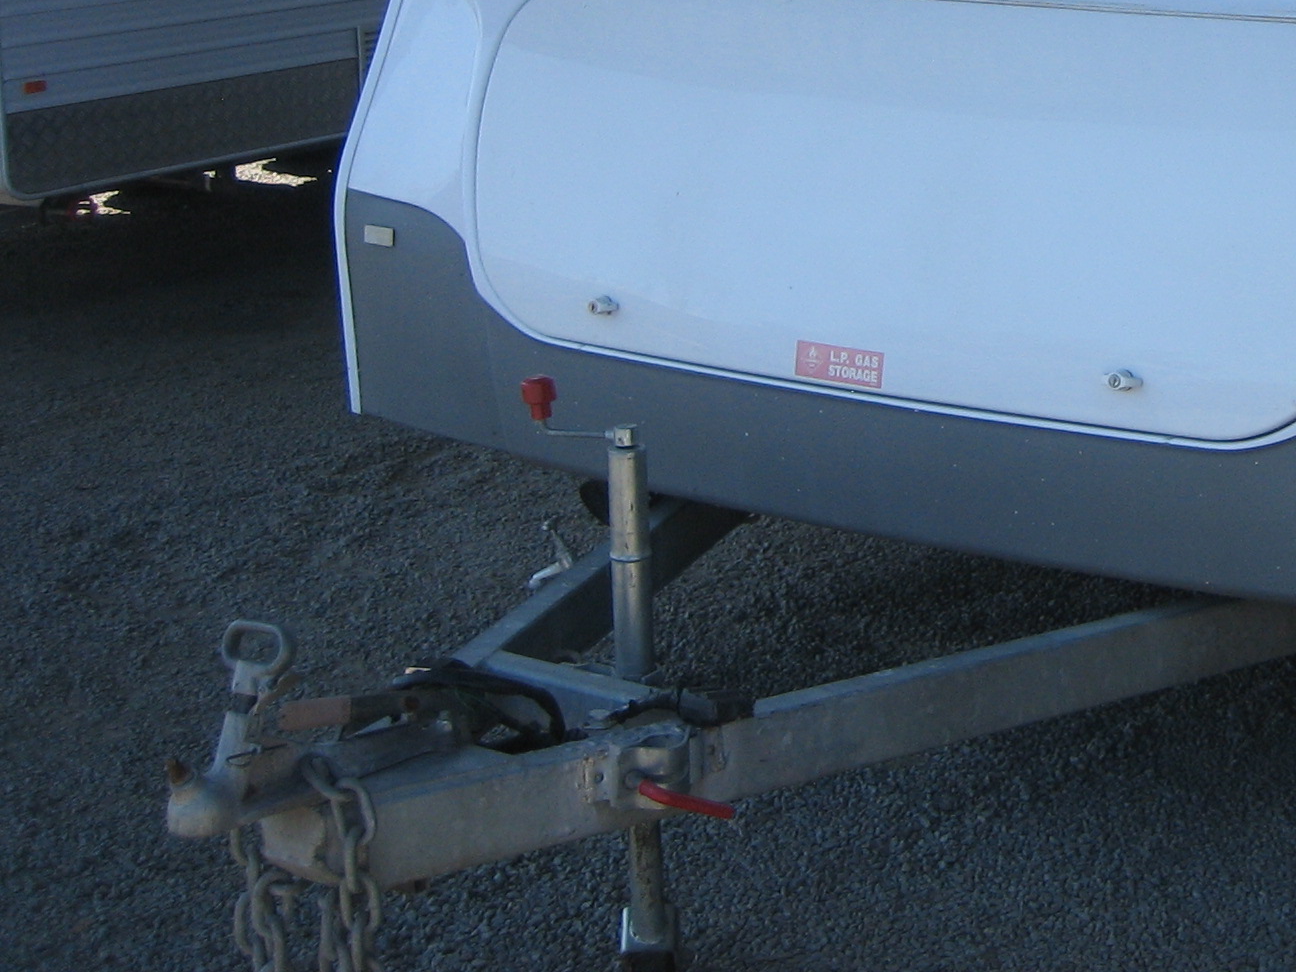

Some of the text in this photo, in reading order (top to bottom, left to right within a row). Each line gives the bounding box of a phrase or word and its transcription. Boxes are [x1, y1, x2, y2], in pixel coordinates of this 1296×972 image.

[830, 350, 880, 368] L.P. GAS
[828, 364, 878, 383] STORAGE
